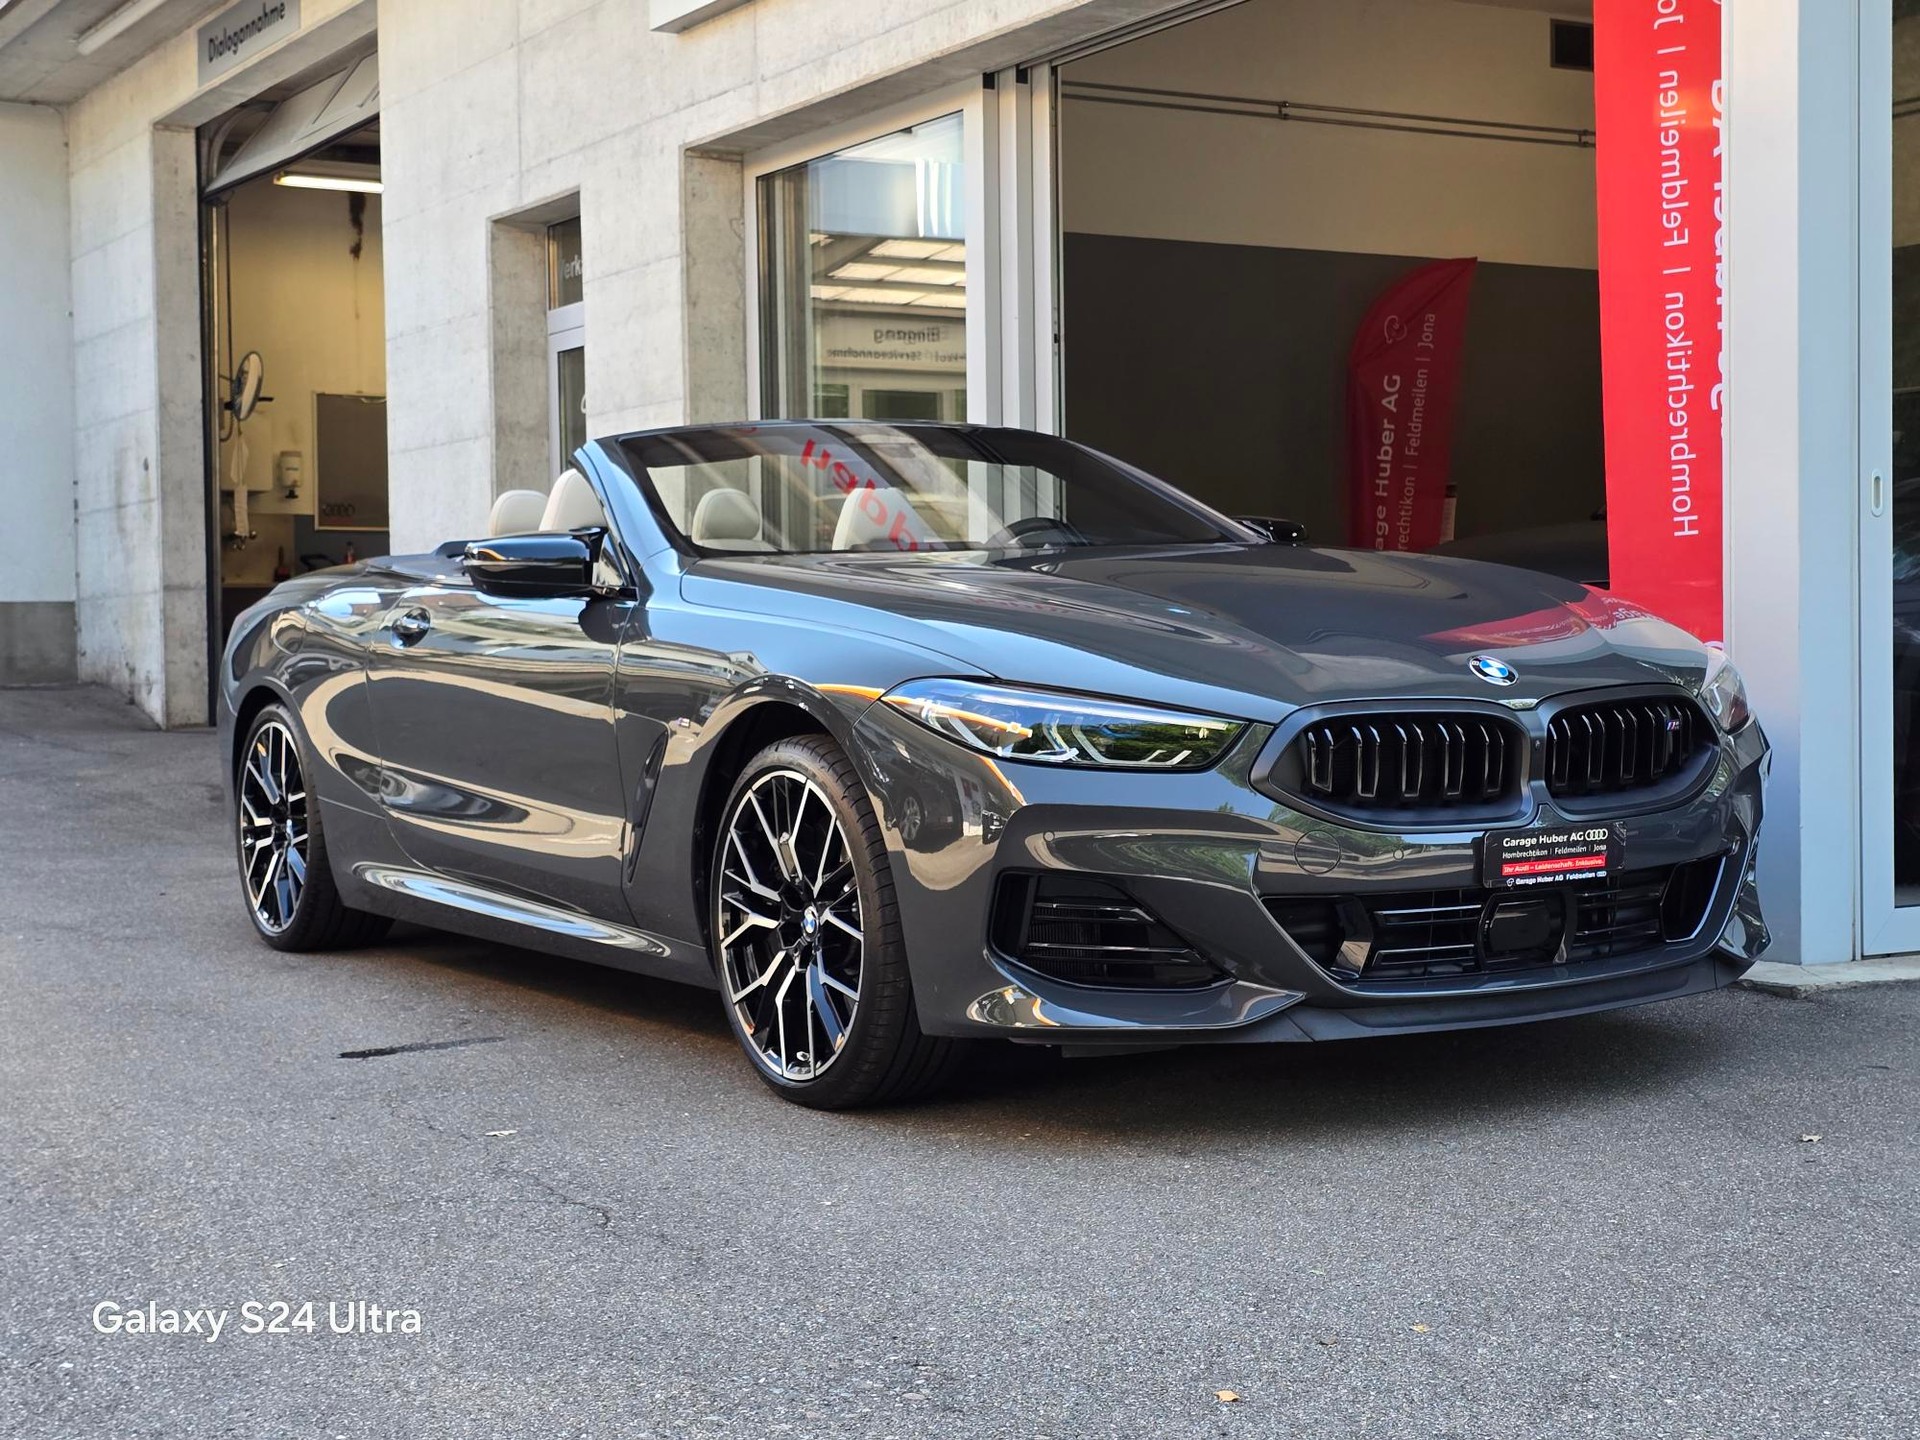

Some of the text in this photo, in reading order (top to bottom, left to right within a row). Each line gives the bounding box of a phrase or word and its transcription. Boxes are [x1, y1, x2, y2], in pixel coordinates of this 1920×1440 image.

[208, 2, 285, 62] Dialogannahme
[1382, 373, 1401, 413] AG
[1405, 367, 1429, 457] Feldmeilen
[1417, 312, 1436, 350] Jona
[1375, 418, 1396, 497] Huber
[1503, 831, 1584, 848] Garage Huber AG
[1554, 845, 1587, 855] Feldmeilen
[1593, 843, 1607, 852] Jona
